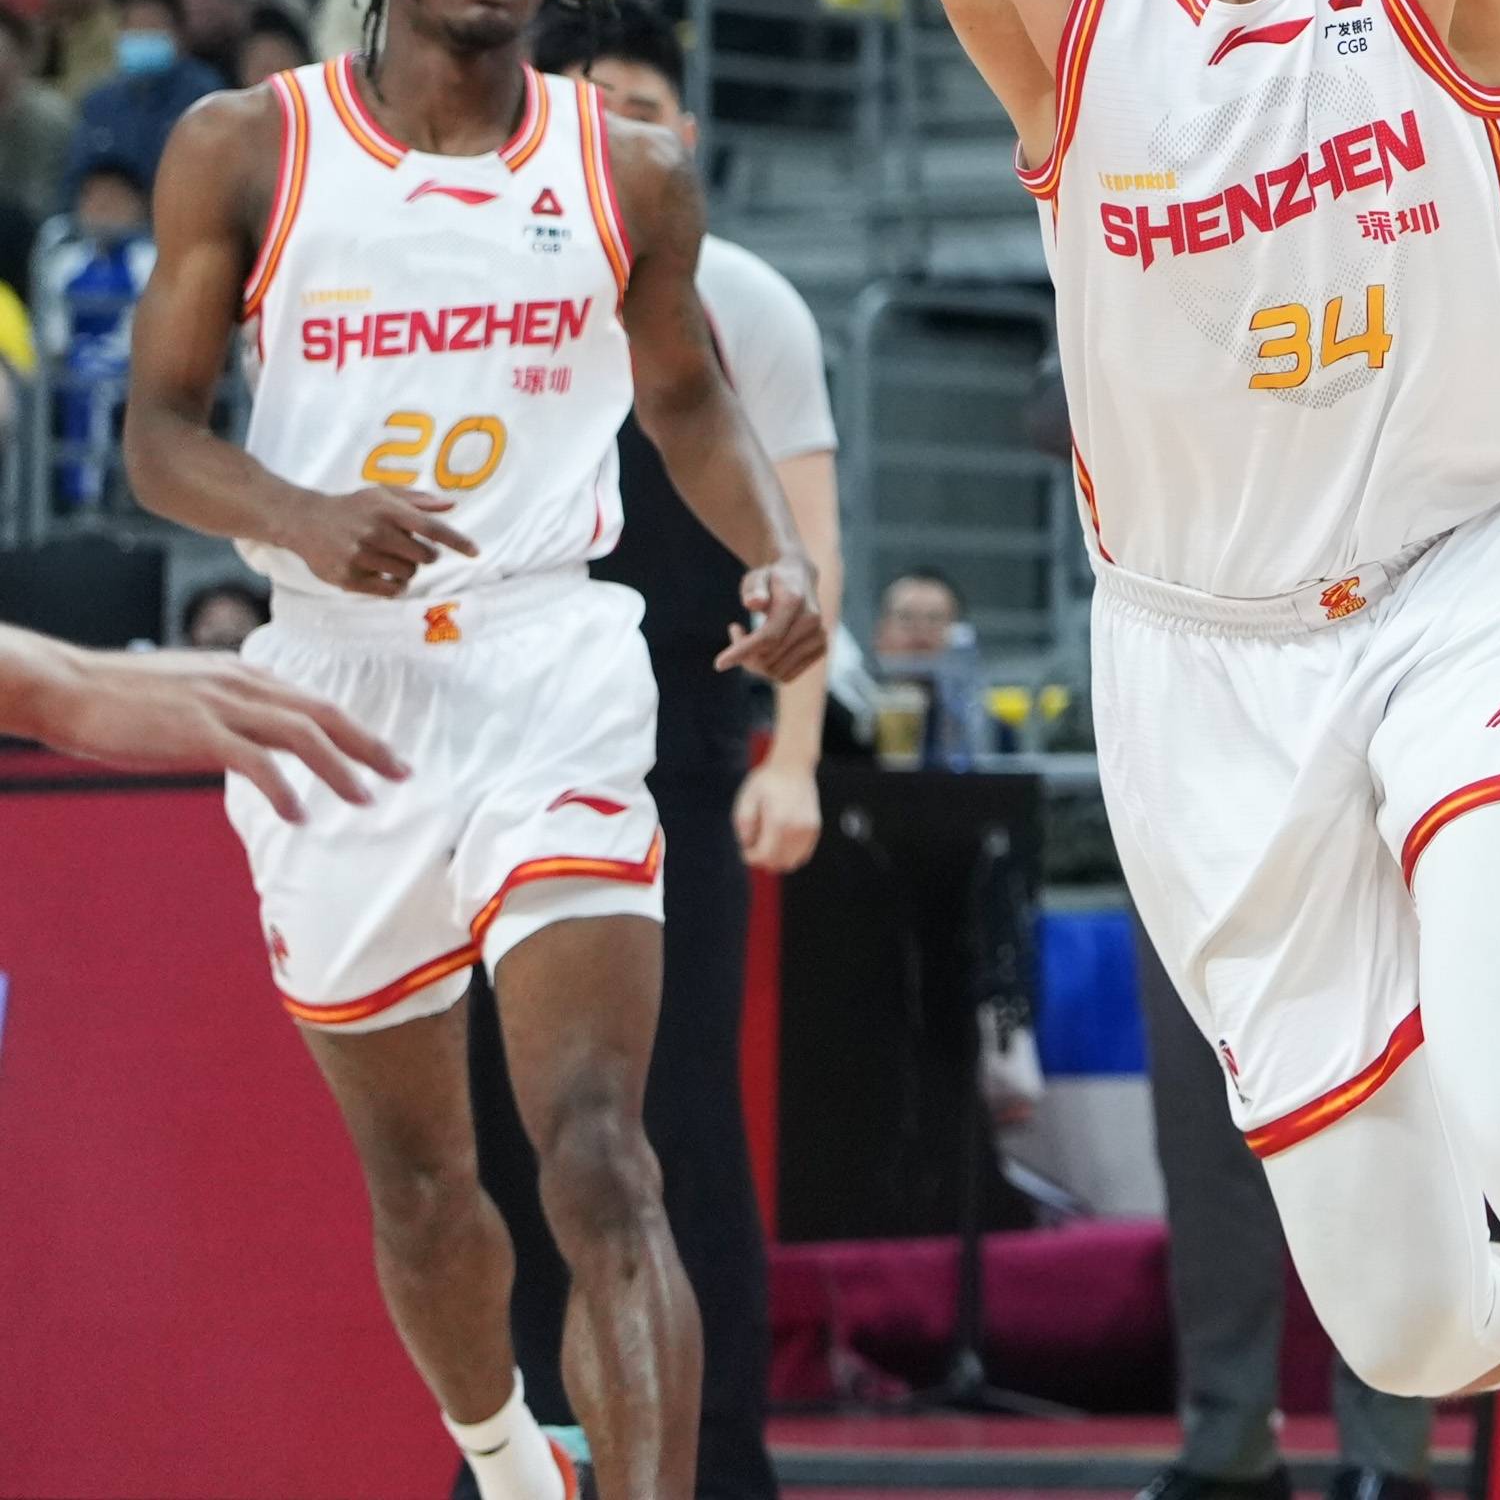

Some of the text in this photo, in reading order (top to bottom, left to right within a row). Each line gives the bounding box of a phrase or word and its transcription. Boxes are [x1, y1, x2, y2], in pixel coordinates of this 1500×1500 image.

[1324, 17, 1373, 39] 广发银行
[1337, 37, 1368, 55] CGB
[1099, 109, 1427, 272] SHENZHEN
[1356, 201, 1441, 245] 深圳
[301, 298, 591, 371] SHENZHEN
[1248, 284, 1393, 390] 34
[361, 411, 508, 491] 20
